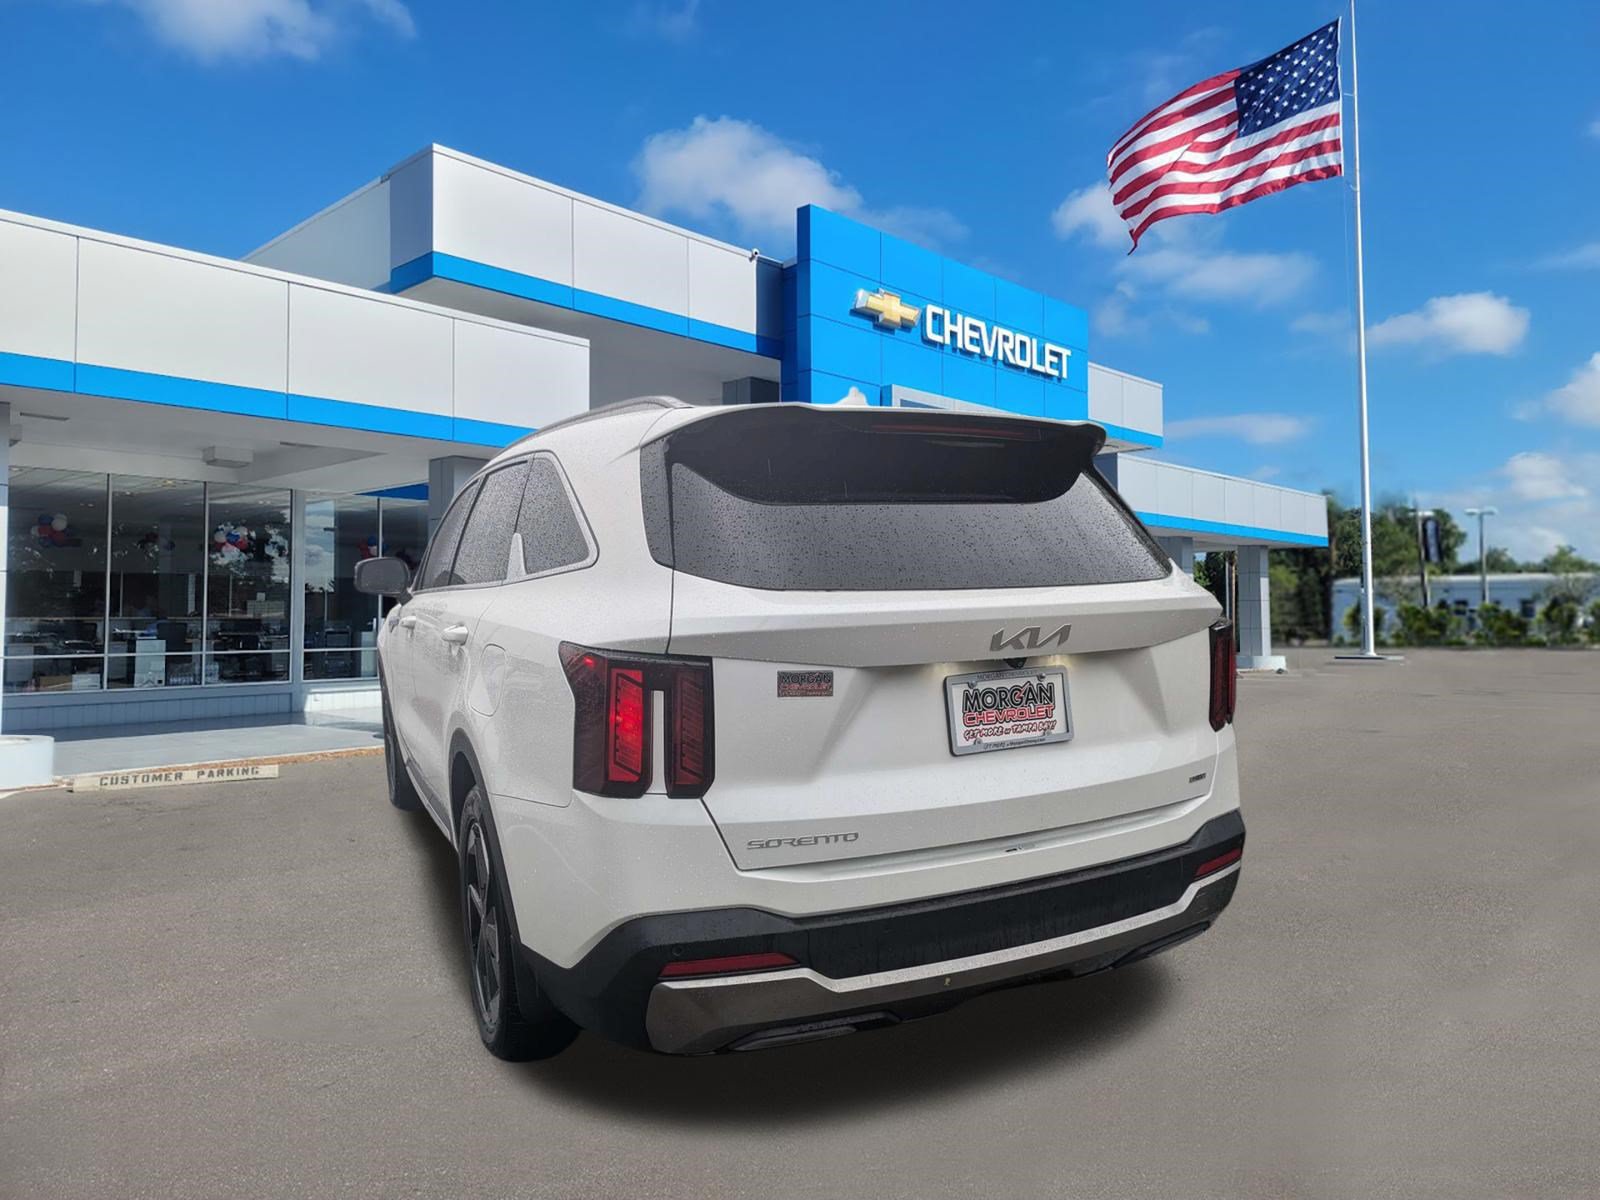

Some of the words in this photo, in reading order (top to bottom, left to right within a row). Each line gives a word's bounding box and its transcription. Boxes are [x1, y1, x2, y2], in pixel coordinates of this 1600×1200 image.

[925, 304, 1072, 379] CHEVROLET
[990, 624, 1071, 651] KIA
[781, 671, 832, 684] MORGAN
[962, 681, 1055, 713] MORGAN
[963, 703, 1055, 727] CHEVROLET
[964, 729, 979, 741] GET
[980, 726, 1003, 738] MORE
[1011, 723, 1037, 735] TAMPA
[100, 772, 183, 786] CUSTOMER
[197, 766, 259, 779] PARKING
[747, 832, 859, 850] SORENTO
